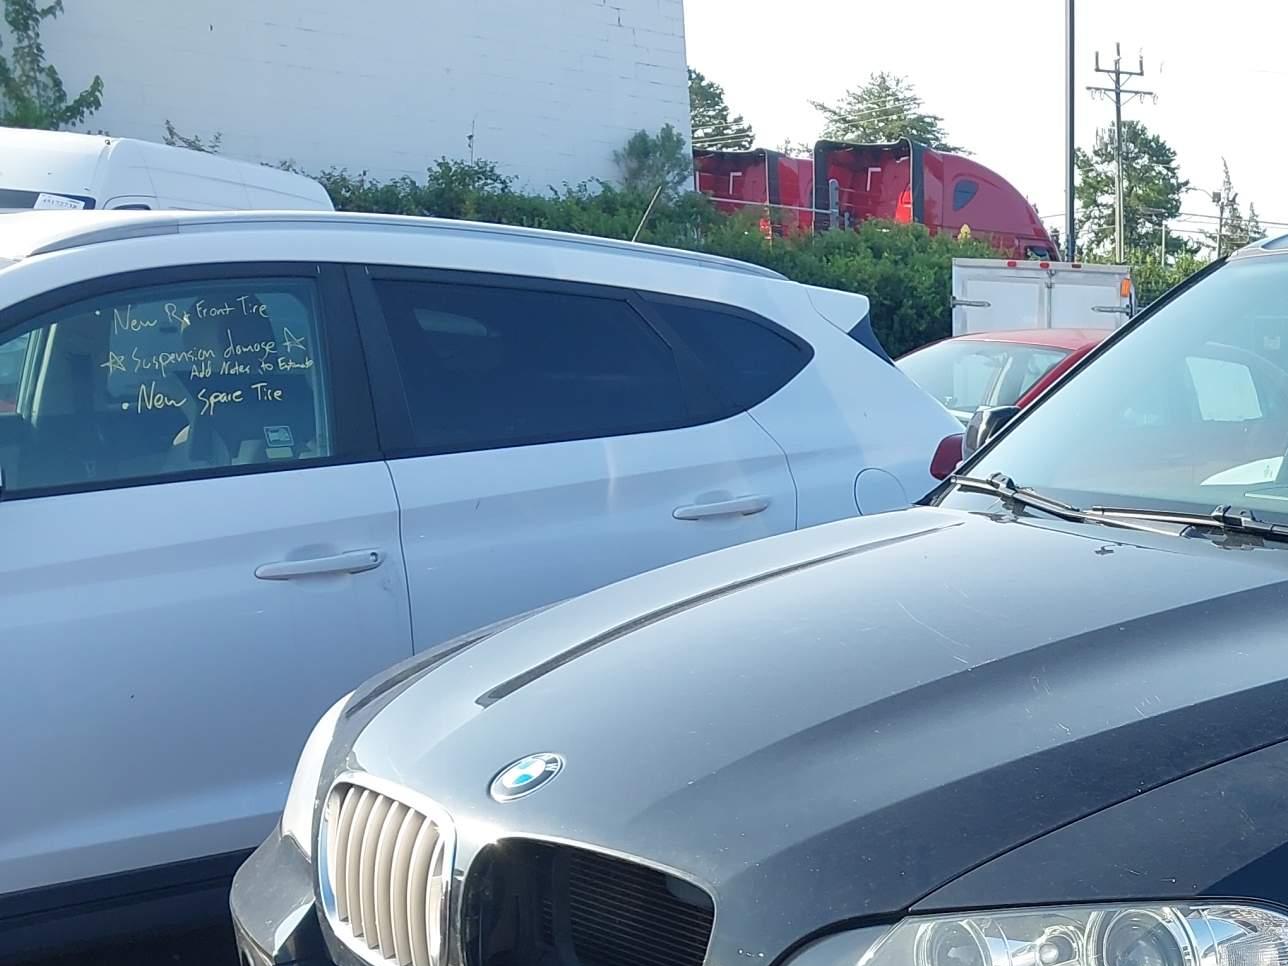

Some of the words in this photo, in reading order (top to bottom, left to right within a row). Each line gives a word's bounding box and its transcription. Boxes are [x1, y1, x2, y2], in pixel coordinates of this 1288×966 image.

[113, 304, 158, 335] New
[196, 300, 235, 318] Front
[236, 296, 270, 318] Tire
[131, 347, 216, 378] Suspension
[223, 328, 277, 359] damage
[190, 360, 212, 380] Add
[220, 361, 250, 376] Notes
[260, 361, 273, 374] to
[137, 381, 187, 414] New
[251, 382, 283, 401] Tire
